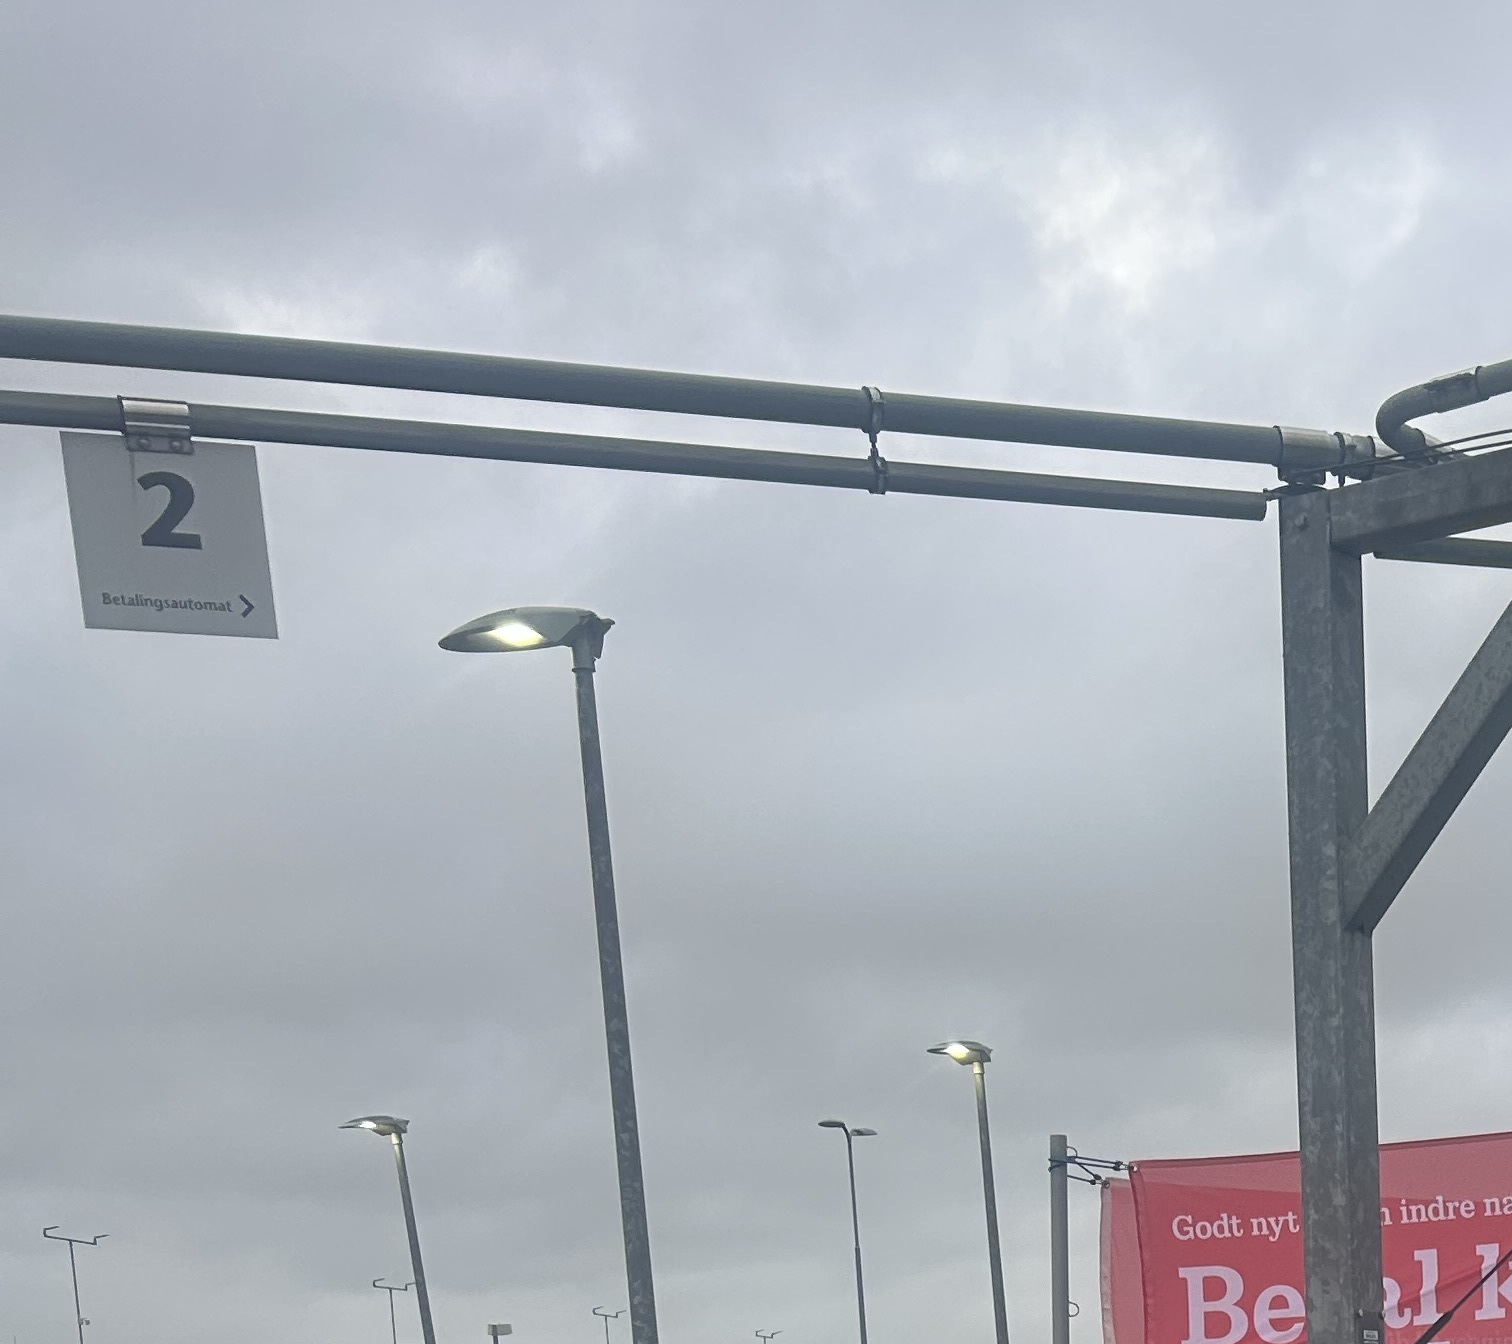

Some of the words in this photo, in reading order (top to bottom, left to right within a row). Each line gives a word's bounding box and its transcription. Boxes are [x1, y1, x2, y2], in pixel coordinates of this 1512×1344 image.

[137, 471, 202, 550] 2
[101, 592, 233, 613] Betalingsautomat
[1171, 1213, 1244, 1241] Godt
[1250, 1211, 1300, 1242] nyt
[1400, 1195, 1476, 1225] indre
